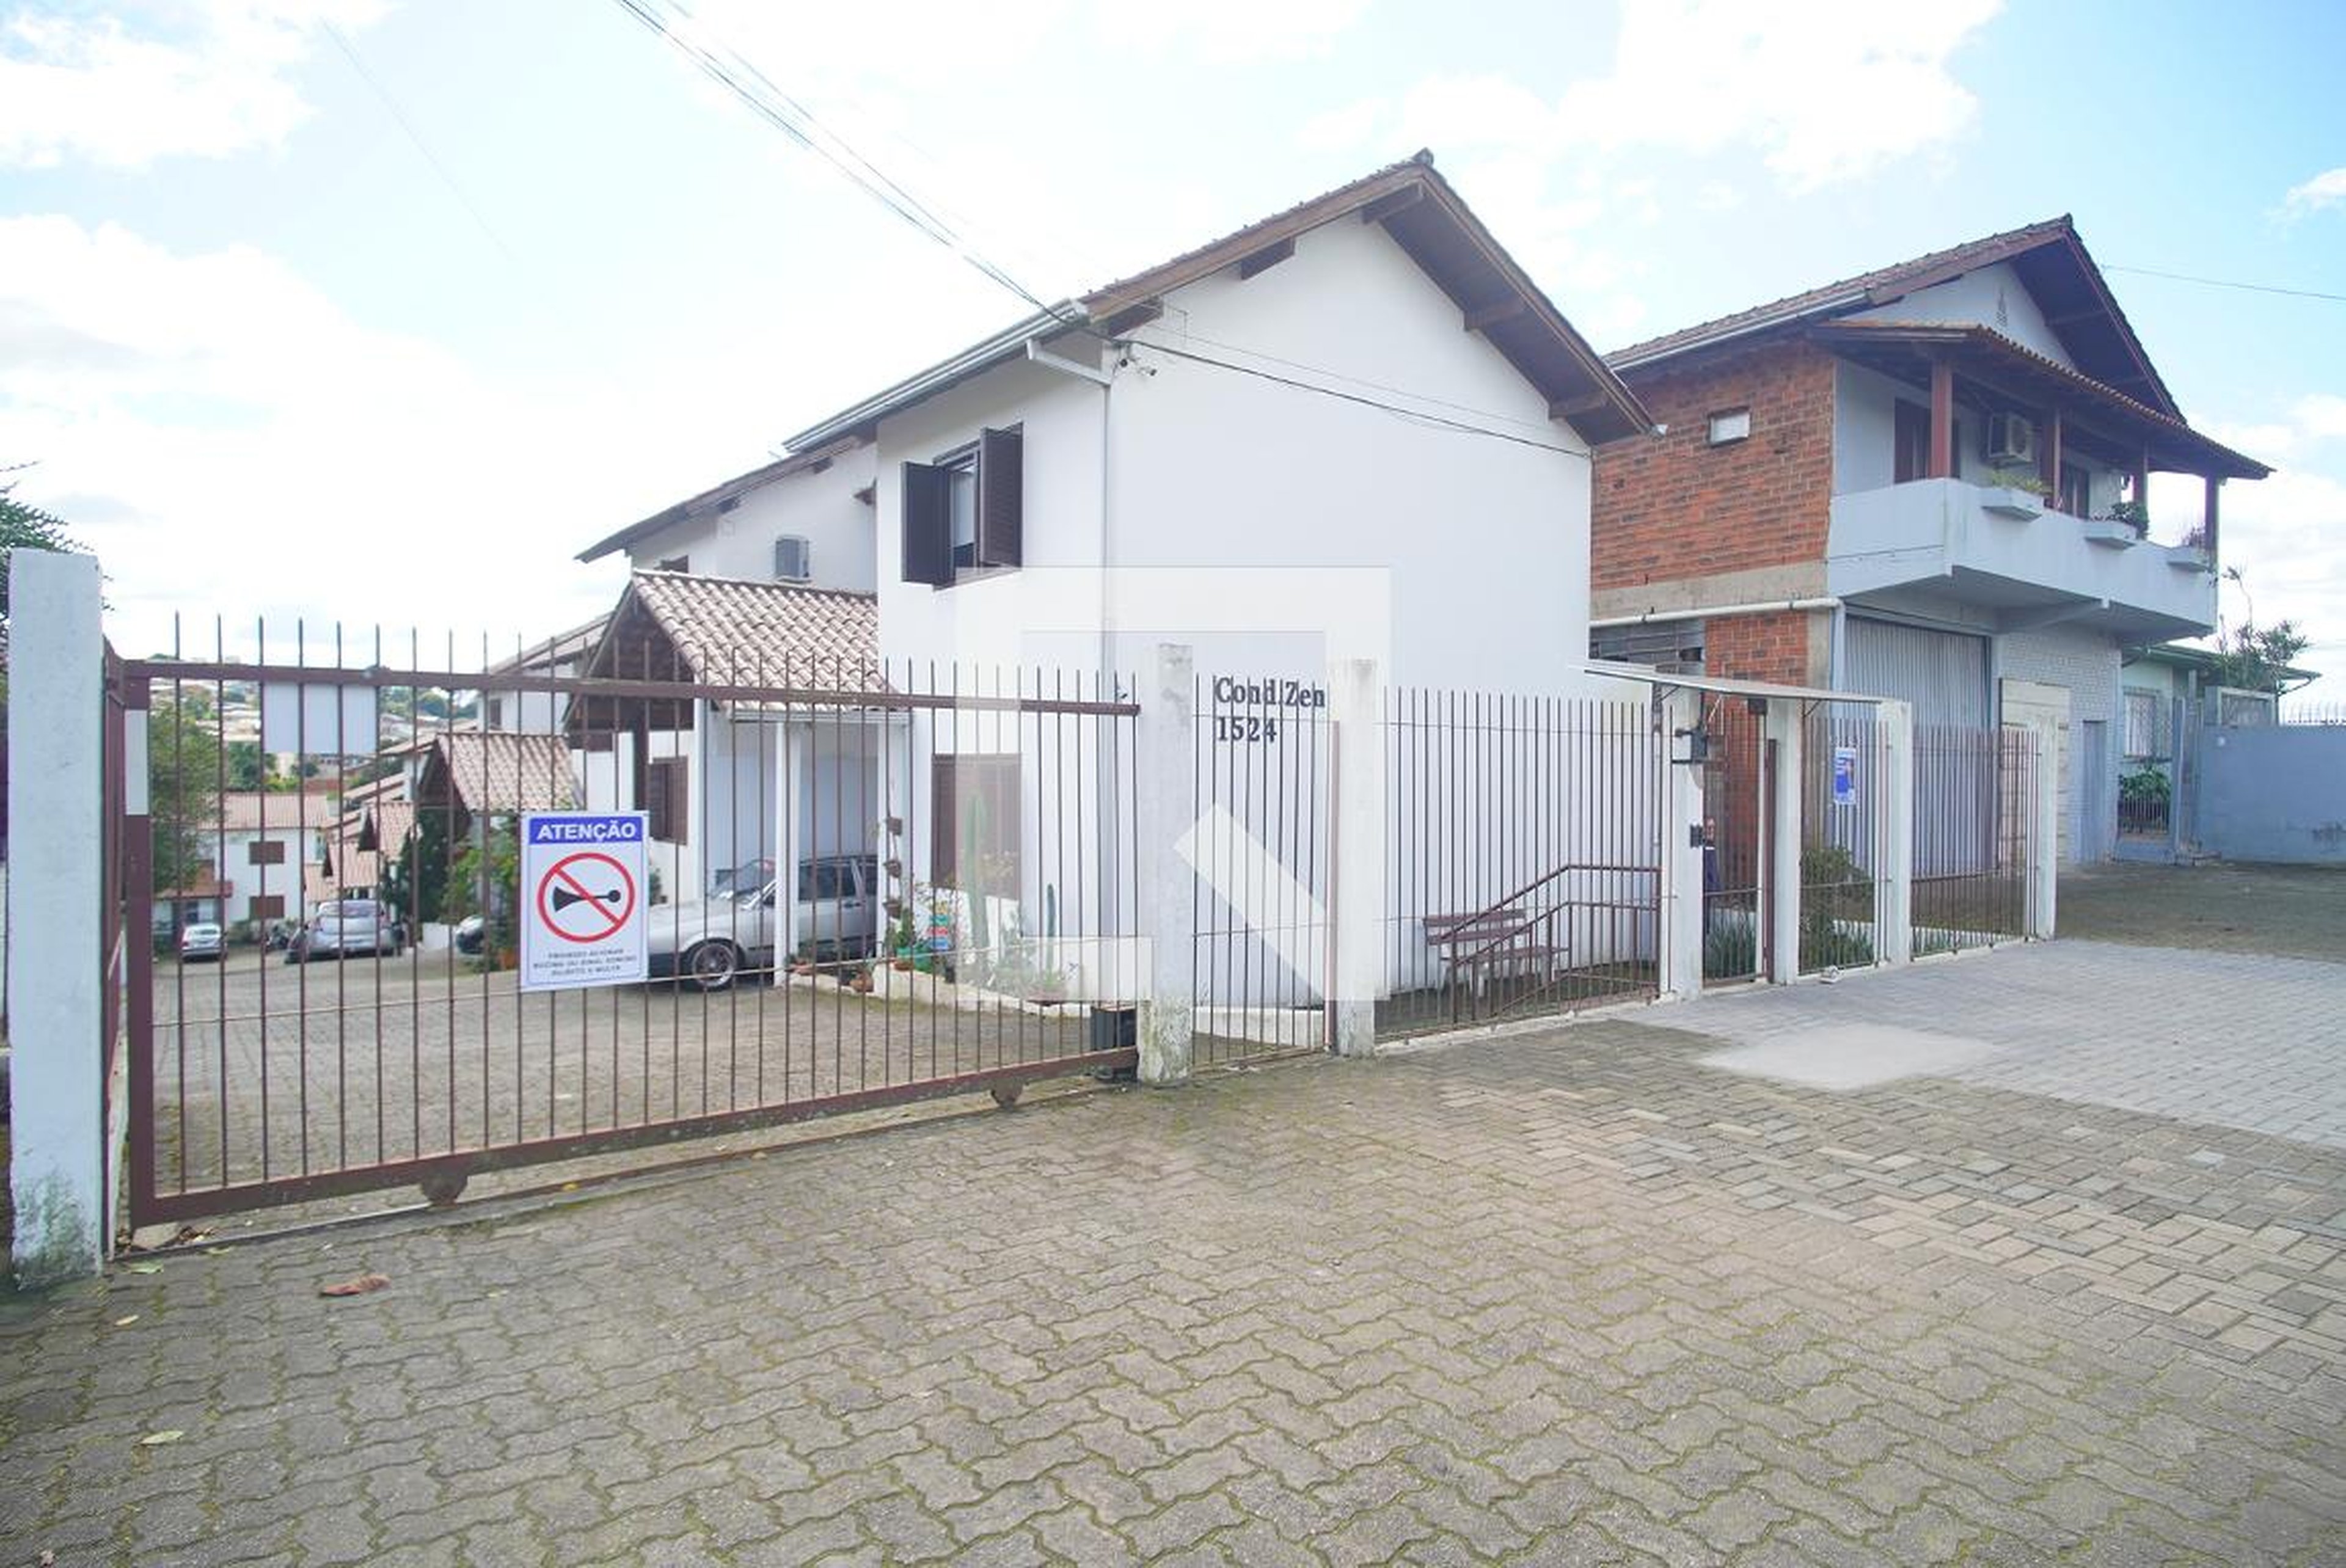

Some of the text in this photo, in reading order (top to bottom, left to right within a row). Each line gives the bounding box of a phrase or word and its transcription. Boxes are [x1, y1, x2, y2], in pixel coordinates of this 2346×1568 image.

[1285, 681, 1325, 707] Zen
[1218, 716, 1277, 743] 1524
[536, 820, 636, 842] ATENÇÃO
